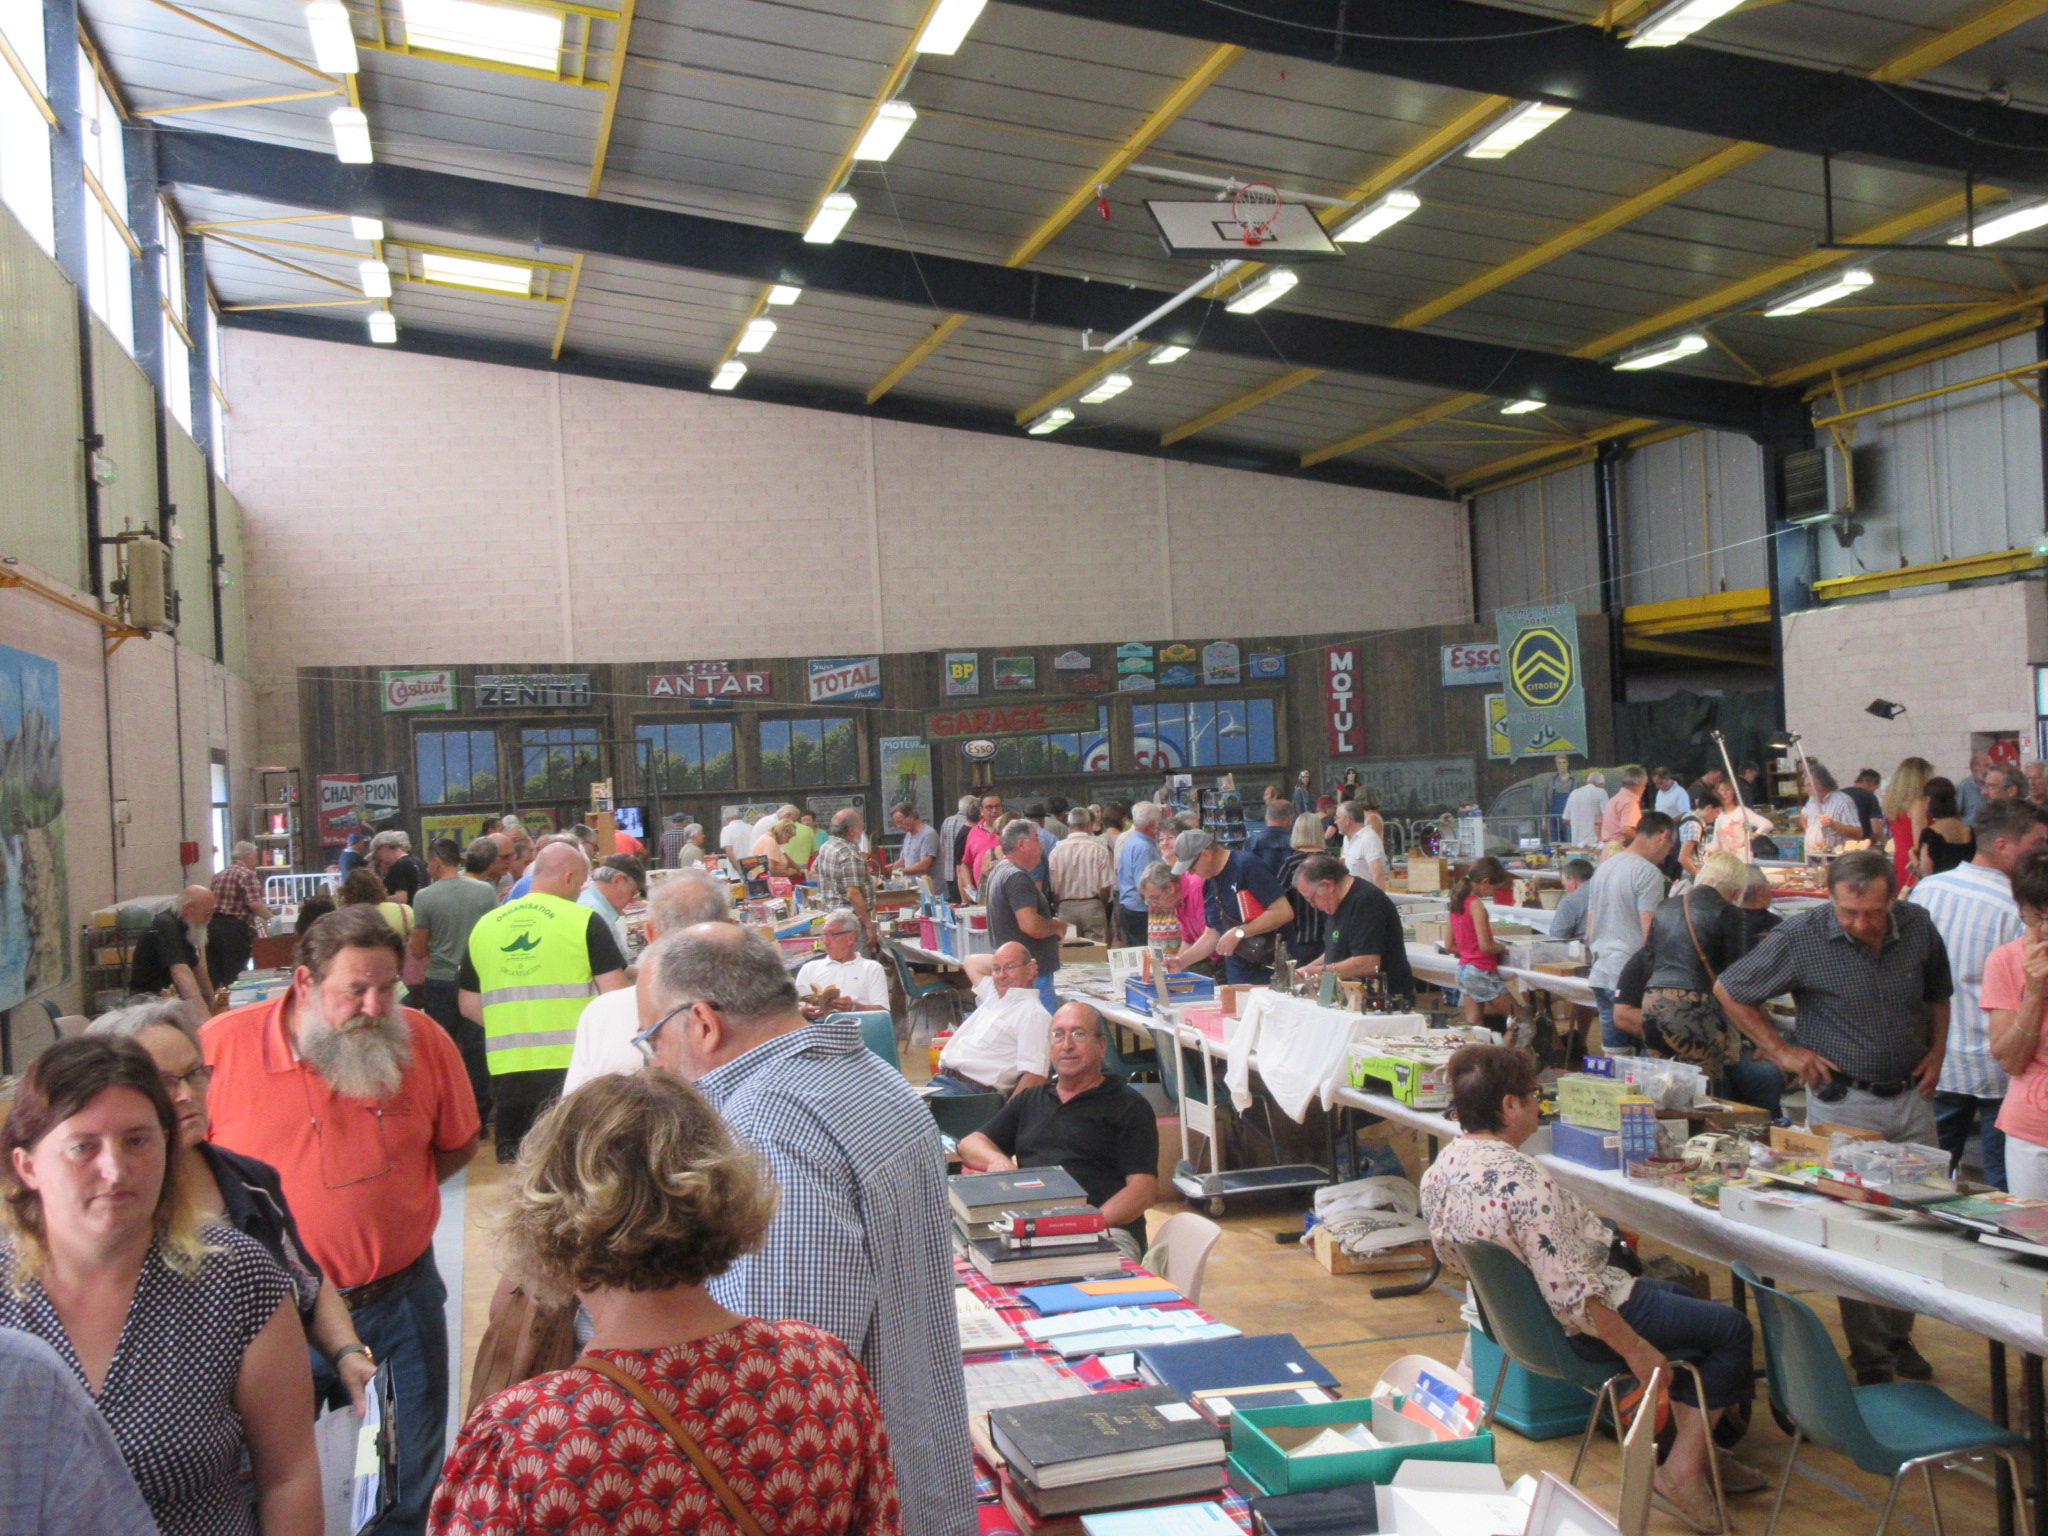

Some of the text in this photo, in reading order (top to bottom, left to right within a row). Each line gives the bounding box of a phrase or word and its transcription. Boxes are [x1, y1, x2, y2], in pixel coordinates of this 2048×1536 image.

[813, 665, 879, 696] TOTAL
[951, 662, 975, 679] BP
[388, 674, 447, 707] Castrol
[480, 683, 588, 705] ZENITH
[653, 674, 764, 695] ANTAR
[1330, 650, 1353, 753] MOTUL
[930, 704, 1048, 736] GARAGE
[496, 902, 556, 922] ORGANISATION
